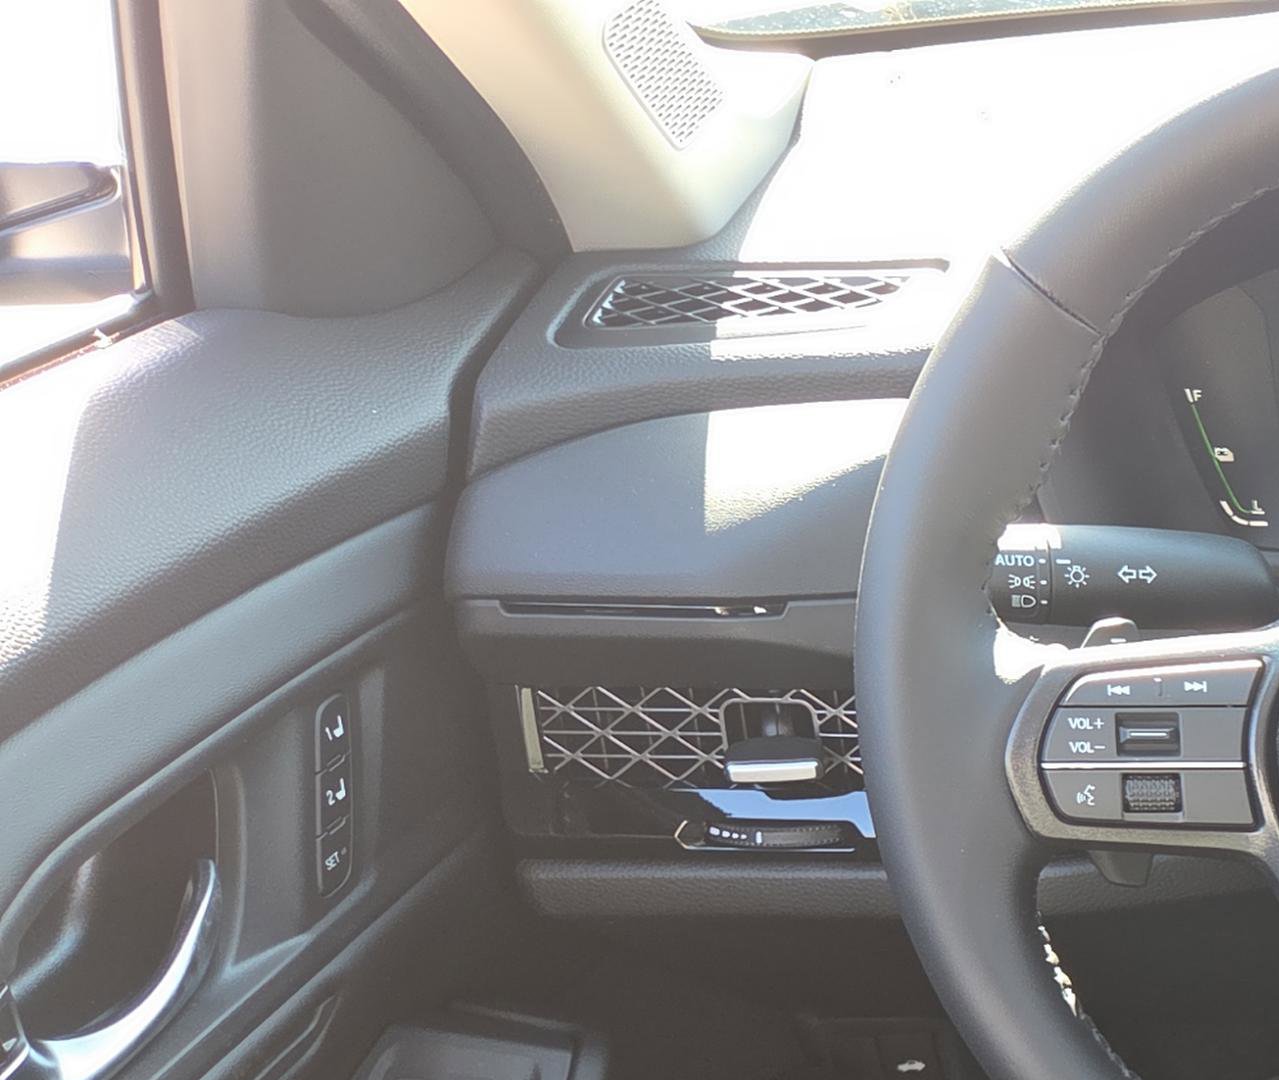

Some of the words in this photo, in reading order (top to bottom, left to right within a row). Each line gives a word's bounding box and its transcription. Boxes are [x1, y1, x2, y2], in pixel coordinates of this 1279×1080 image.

[995, 554, 1035, 567] AUTO
[1068, 717, 1104, 730] VOL+
[325, 851, 341, 871] SET
